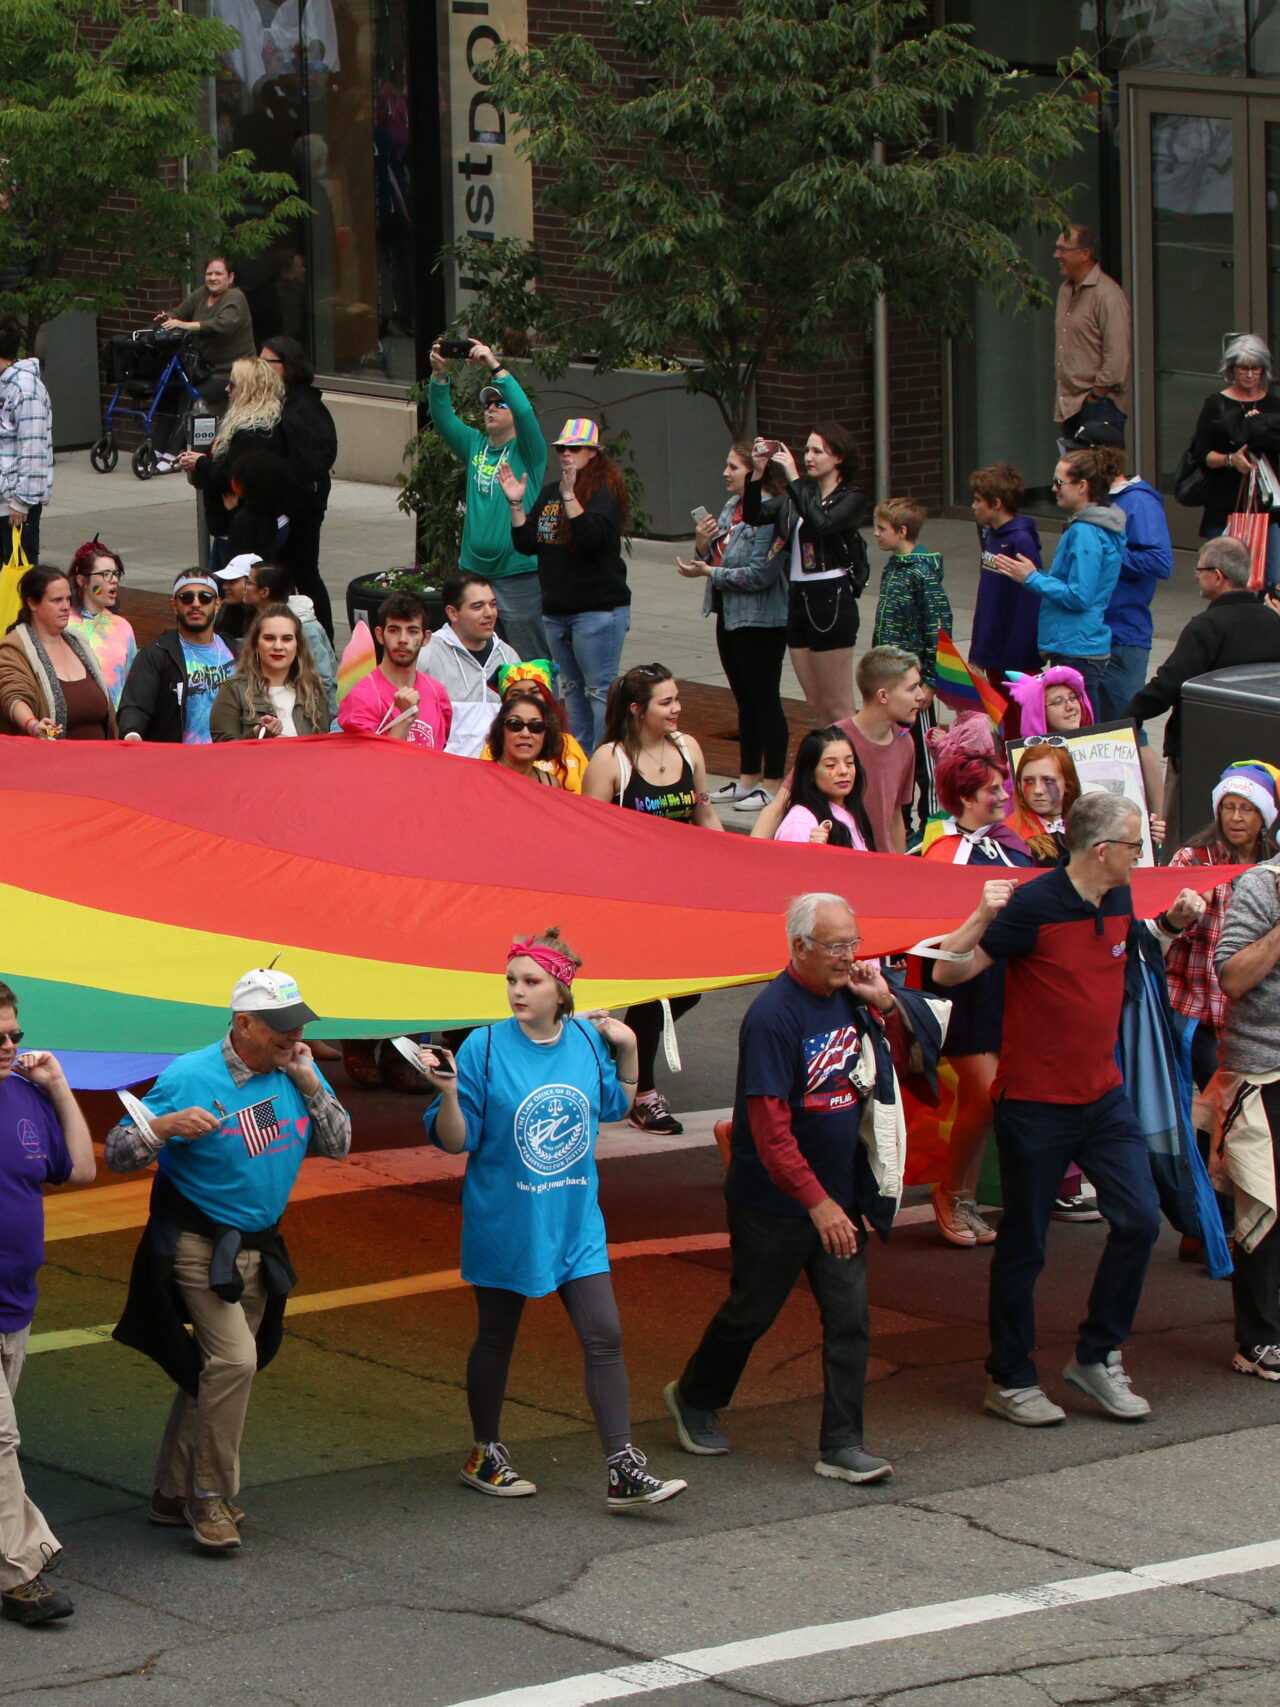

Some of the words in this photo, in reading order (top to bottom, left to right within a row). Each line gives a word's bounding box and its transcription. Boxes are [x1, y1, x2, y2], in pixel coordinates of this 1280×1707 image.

[1089, 743, 1111, 760] ARE
[1113, 744, 1136, 761] MEN
[829, 1092, 852, 1107] PFLAG
